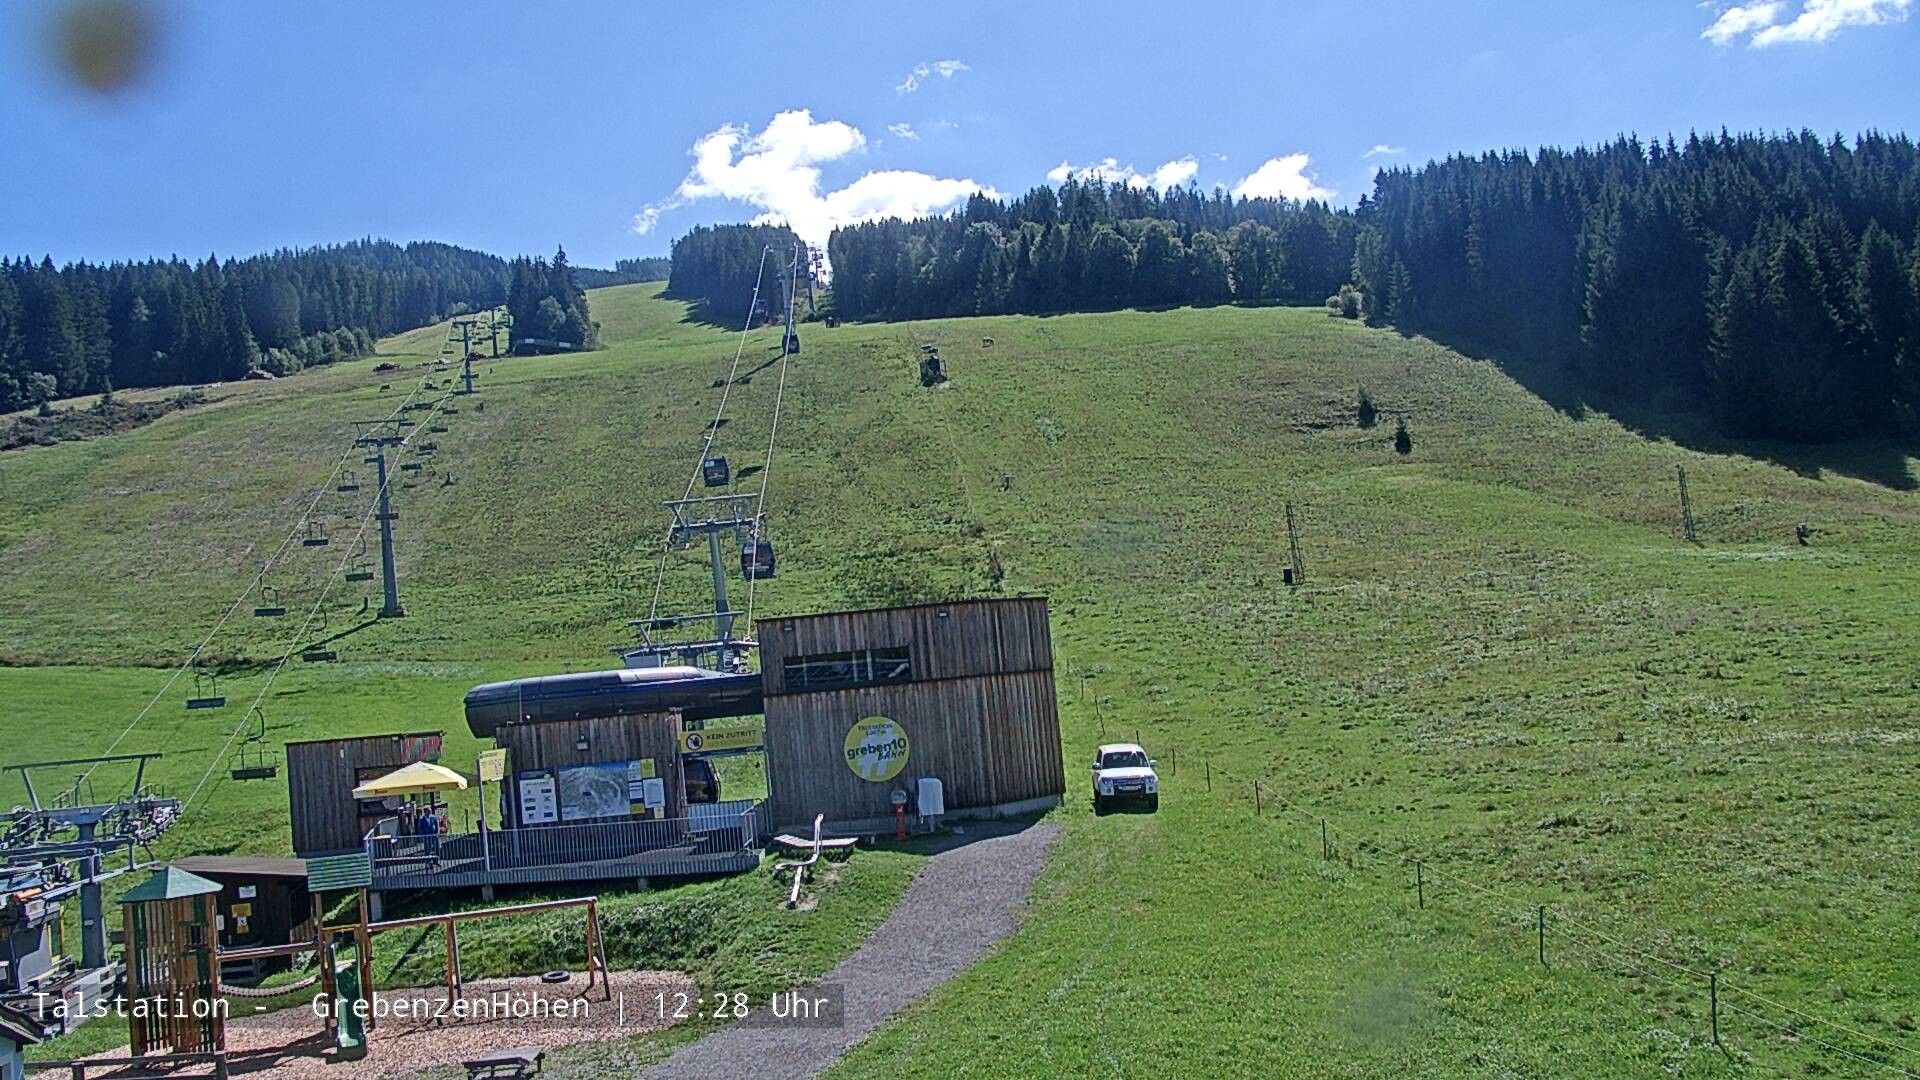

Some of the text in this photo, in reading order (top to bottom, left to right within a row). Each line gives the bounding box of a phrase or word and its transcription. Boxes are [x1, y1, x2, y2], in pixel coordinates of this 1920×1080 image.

[726, 730, 756, 738] ZUTRITT
[846, 737, 907, 760] greben10
[877, 750, 906, 761] BAHN
